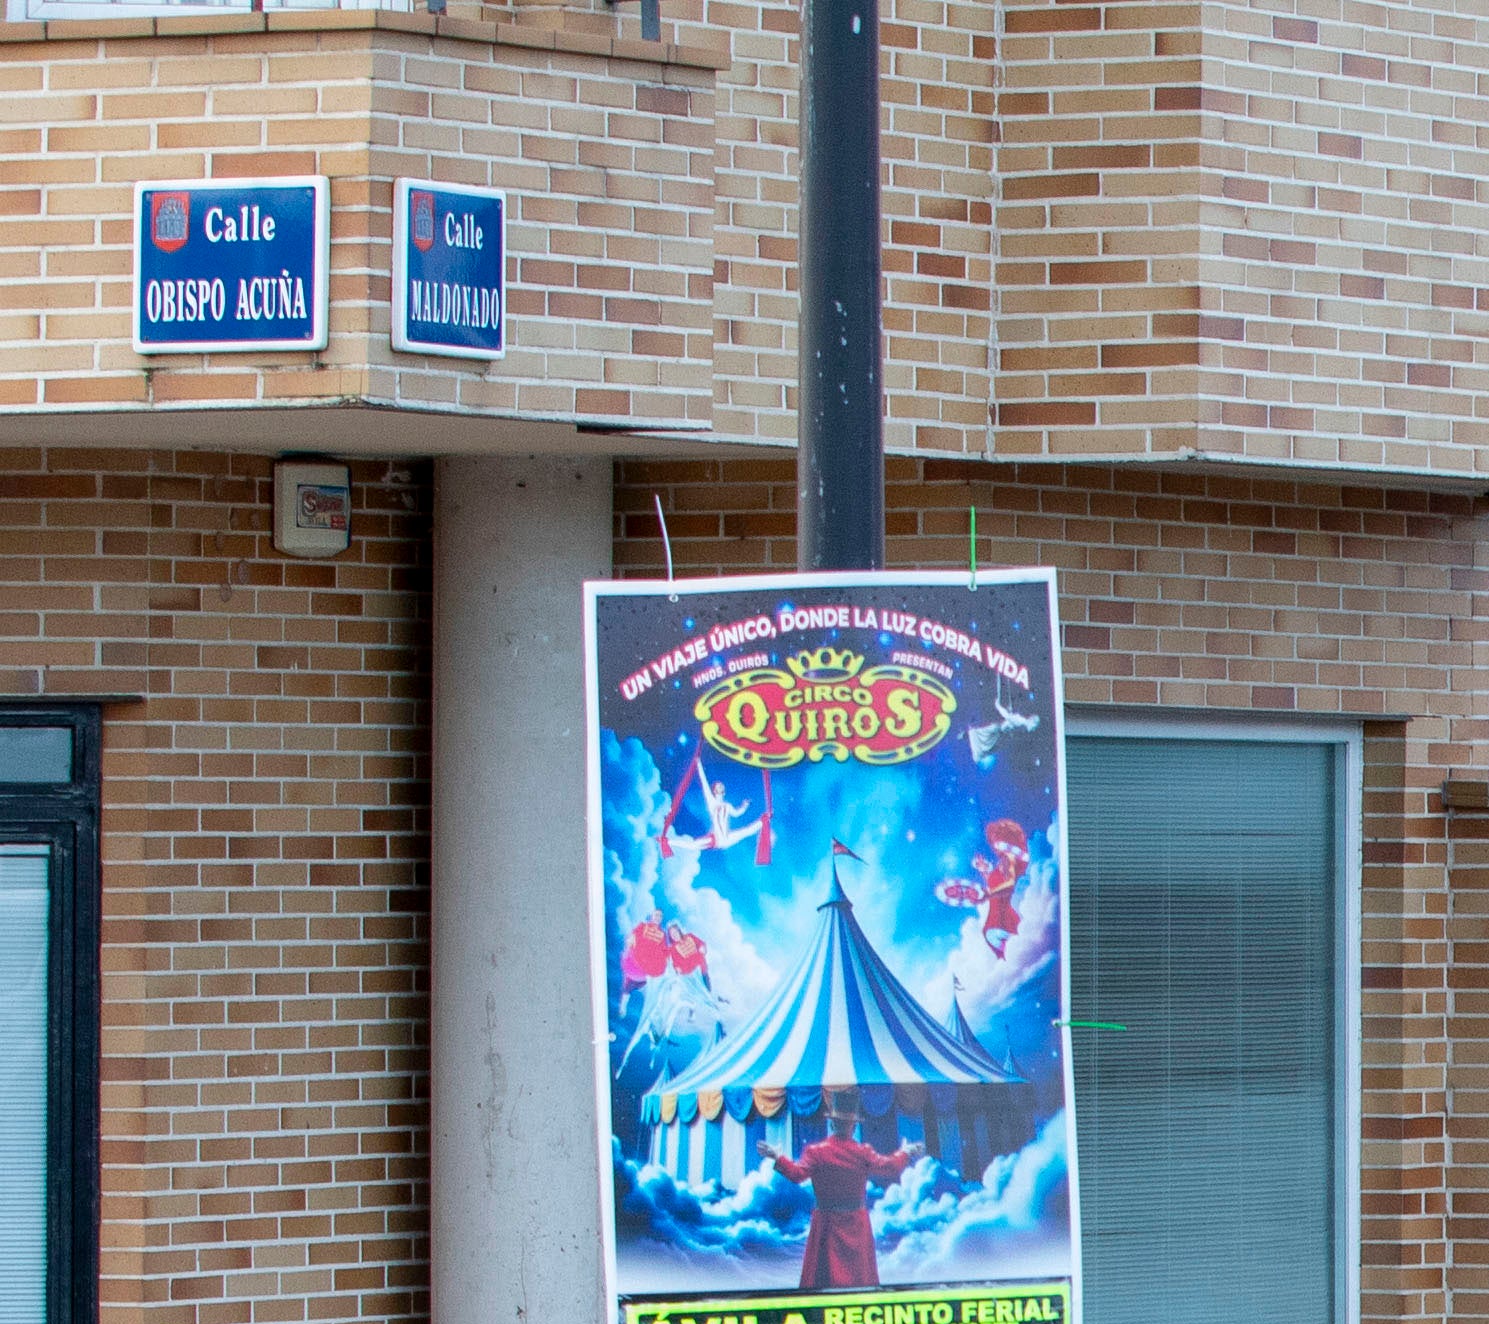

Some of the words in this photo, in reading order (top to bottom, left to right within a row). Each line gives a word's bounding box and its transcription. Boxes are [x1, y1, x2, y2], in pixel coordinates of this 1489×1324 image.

[205, 205, 276, 243] Calle
[444, 212, 483, 250] Calle
[147, 278, 226, 323] OBISPO
[236, 269, 308, 320] ACUÑA
[411, 279, 500, 330] MALDONADO
[622, 669, 652, 700] UN
[653, 639, 709, 679] VIAJE
[710, 617, 777, 652] ÚNICO,
[780, 607, 849, 632] DONDE
[854, 608, 878, 629] LA
[882, 611, 917, 636] LUZ
[919, 621, 983, 662] COBRA
[986, 647, 1030, 689] VIDA
[893, 652, 953, 679] PRESENTAN
[784, 685, 873, 708] CIRCO
[726, 689, 921, 743] QUIROS
[961, 1298, 1059, 1323] FERIAL
